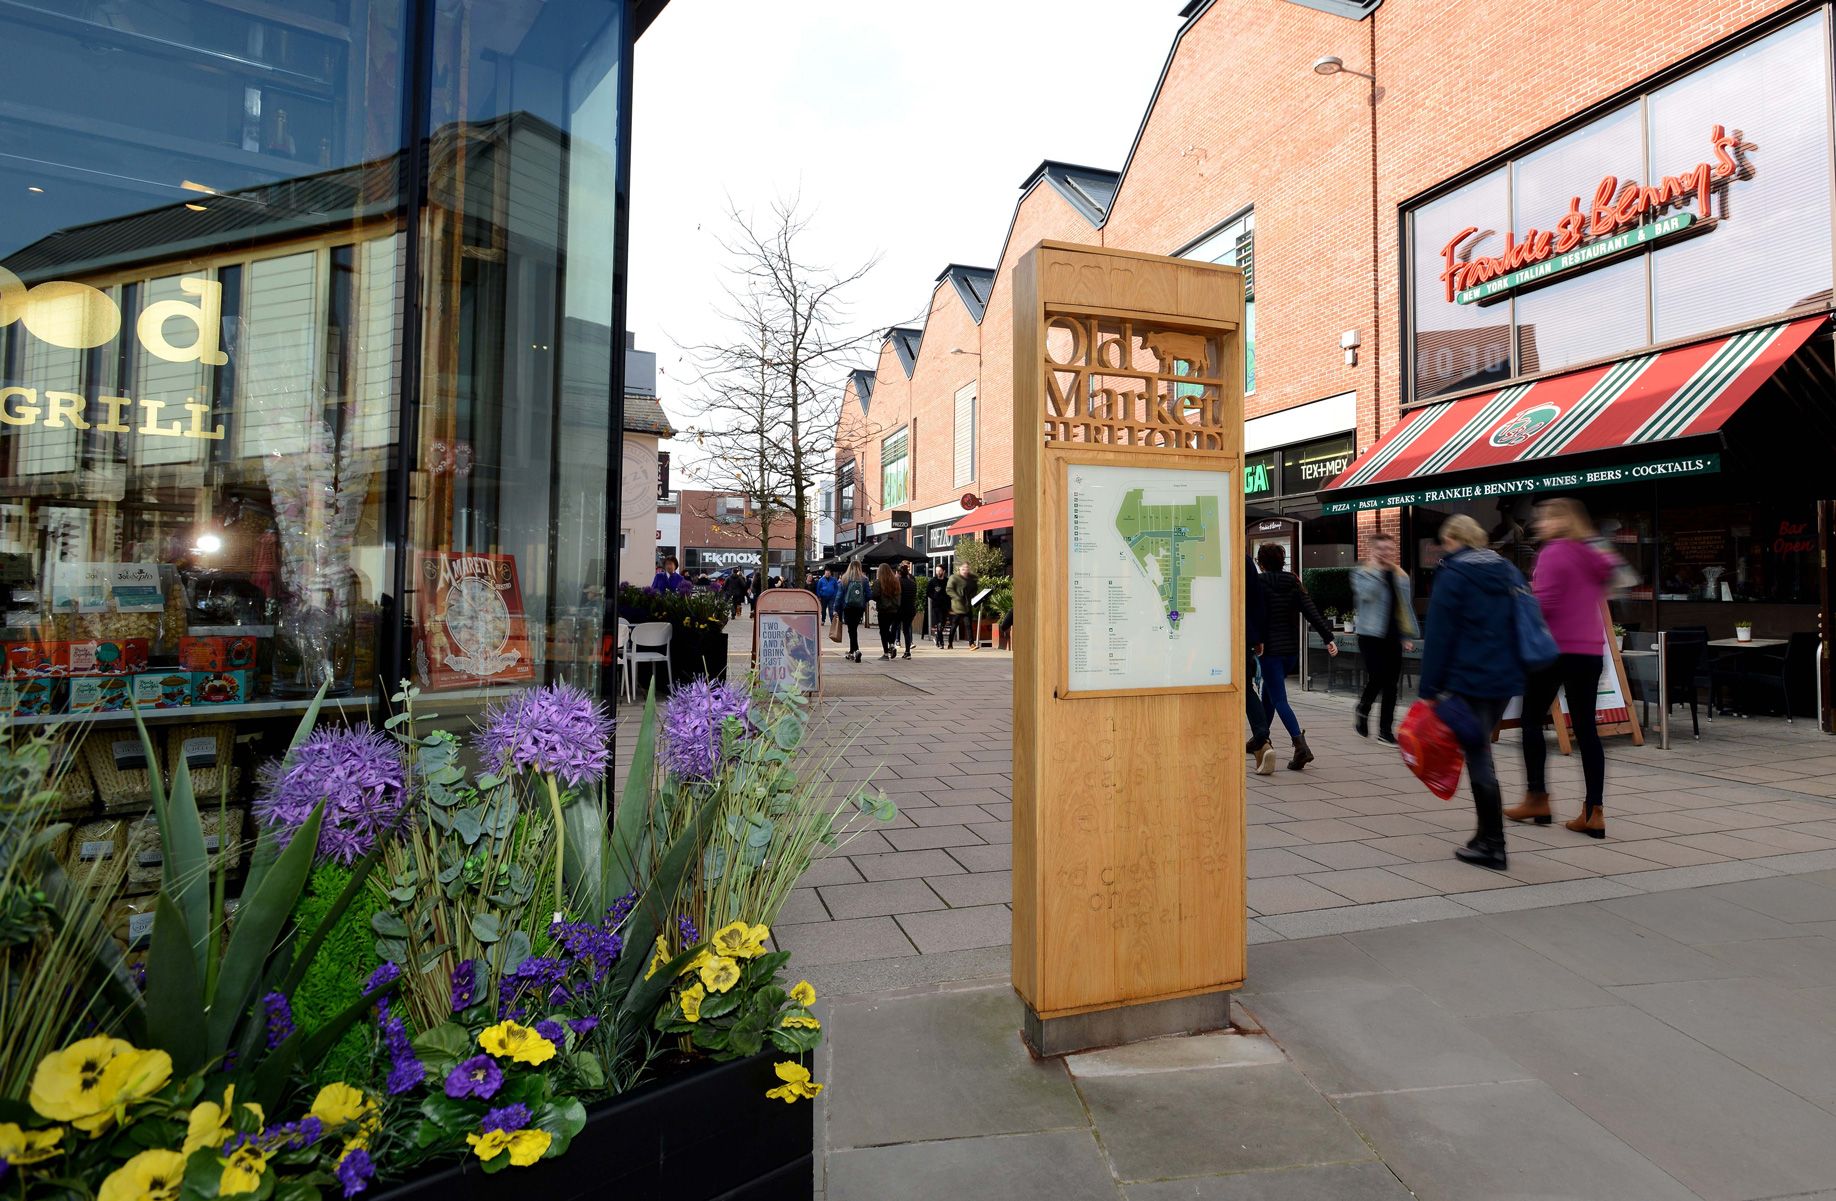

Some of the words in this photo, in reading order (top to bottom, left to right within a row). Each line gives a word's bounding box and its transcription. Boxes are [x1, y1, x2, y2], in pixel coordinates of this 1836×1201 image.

[1440, 226, 1553, 302] Frankie
[1556, 196, 1586, 252] &
[1590, 124, 1740, 236] Benny's
[1463, 290, 1481, 302] NEW
[1487, 279, 1509, 293] YORK
[1516, 264, 1552, 284] ITALIAN
[1561, 235, 1629, 268] RESTAURANT
[1637, 230, 1646, 242] &
[1655, 217, 1679, 235] BAR
[1043, 315, 1138, 371] Old
[0, 386, 225, 440] GRILL
[1043, 366, 1223, 429] Market
[1043, 420, 1224, 451] HEREFORD
[1332, 503, 1350, 512] PIZZA
[1359, 500, 1378, 509] PASTA
[1387, 495, 1415, 506] STEAKS
[1425, 486, 1473, 502] FRANKIE
[1474, 485, 1482, 496] &
[1483, 479, 1534, 495] BENNY'S
[1542, 475, 1577, 487] WINES
[1586, 469, 1622, 483] BEERS
[1632, 459, 1704, 477] COCKTAILS
[1778, 521, 1808, 536] Bar
[1772, 538, 1815, 560] Open
[437, 553, 498, 591] AMARETTI
[762, 622, 779, 630] TWO
[762, 631, 794, 639] COURSES
[763, 640, 778, 648] AND
[763, 648, 785, 657] DRINK
[763, 657, 783, 666] JUST
